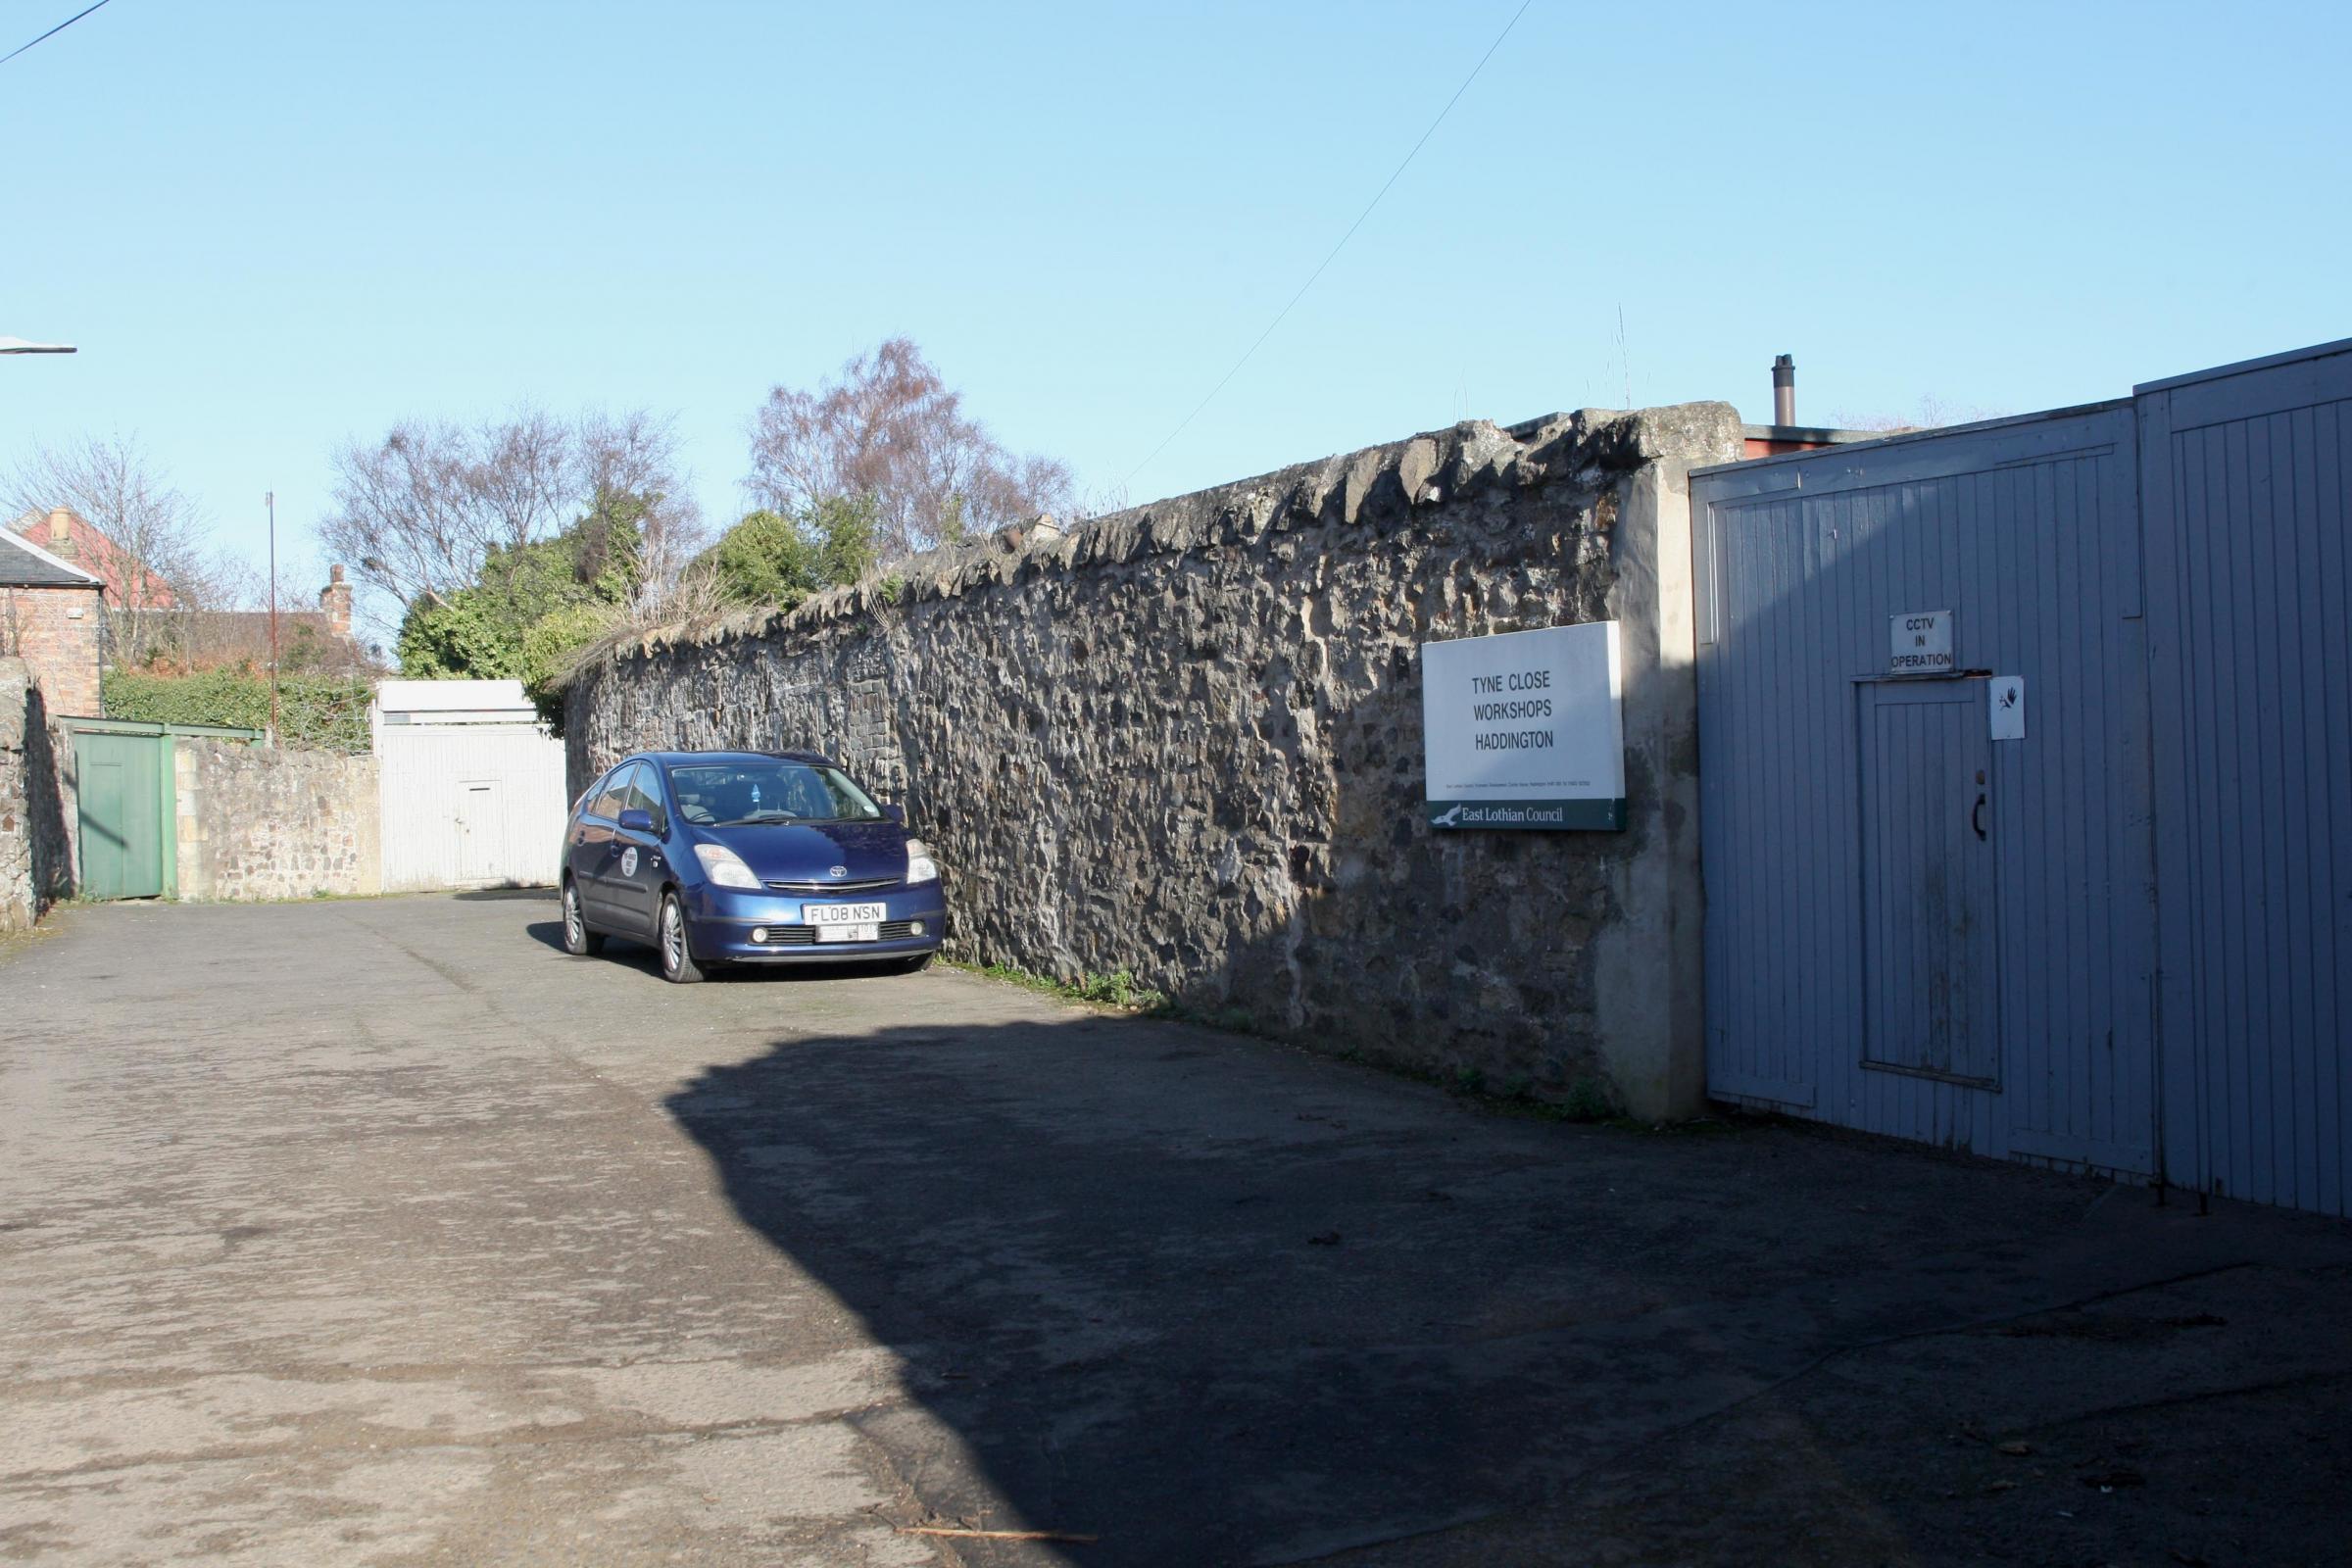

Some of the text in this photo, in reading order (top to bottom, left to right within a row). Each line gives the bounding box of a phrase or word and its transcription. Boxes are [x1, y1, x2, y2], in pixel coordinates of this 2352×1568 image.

[1906, 617, 1935, 631] CCTV
[1915, 635, 1926, 647] IN
[1890, 654, 1951, 667] OPERATION
[1472, 670, 1550, 694] TYNE CLOSE
[1474, 699, 1551, 721] WORKSHOPS
[1476, 730, 1553, 751] HADDINGTON
[1462, 808, 1563, 822] East Lothian Council
[810, 906, 880, 921] FL08 NSN
